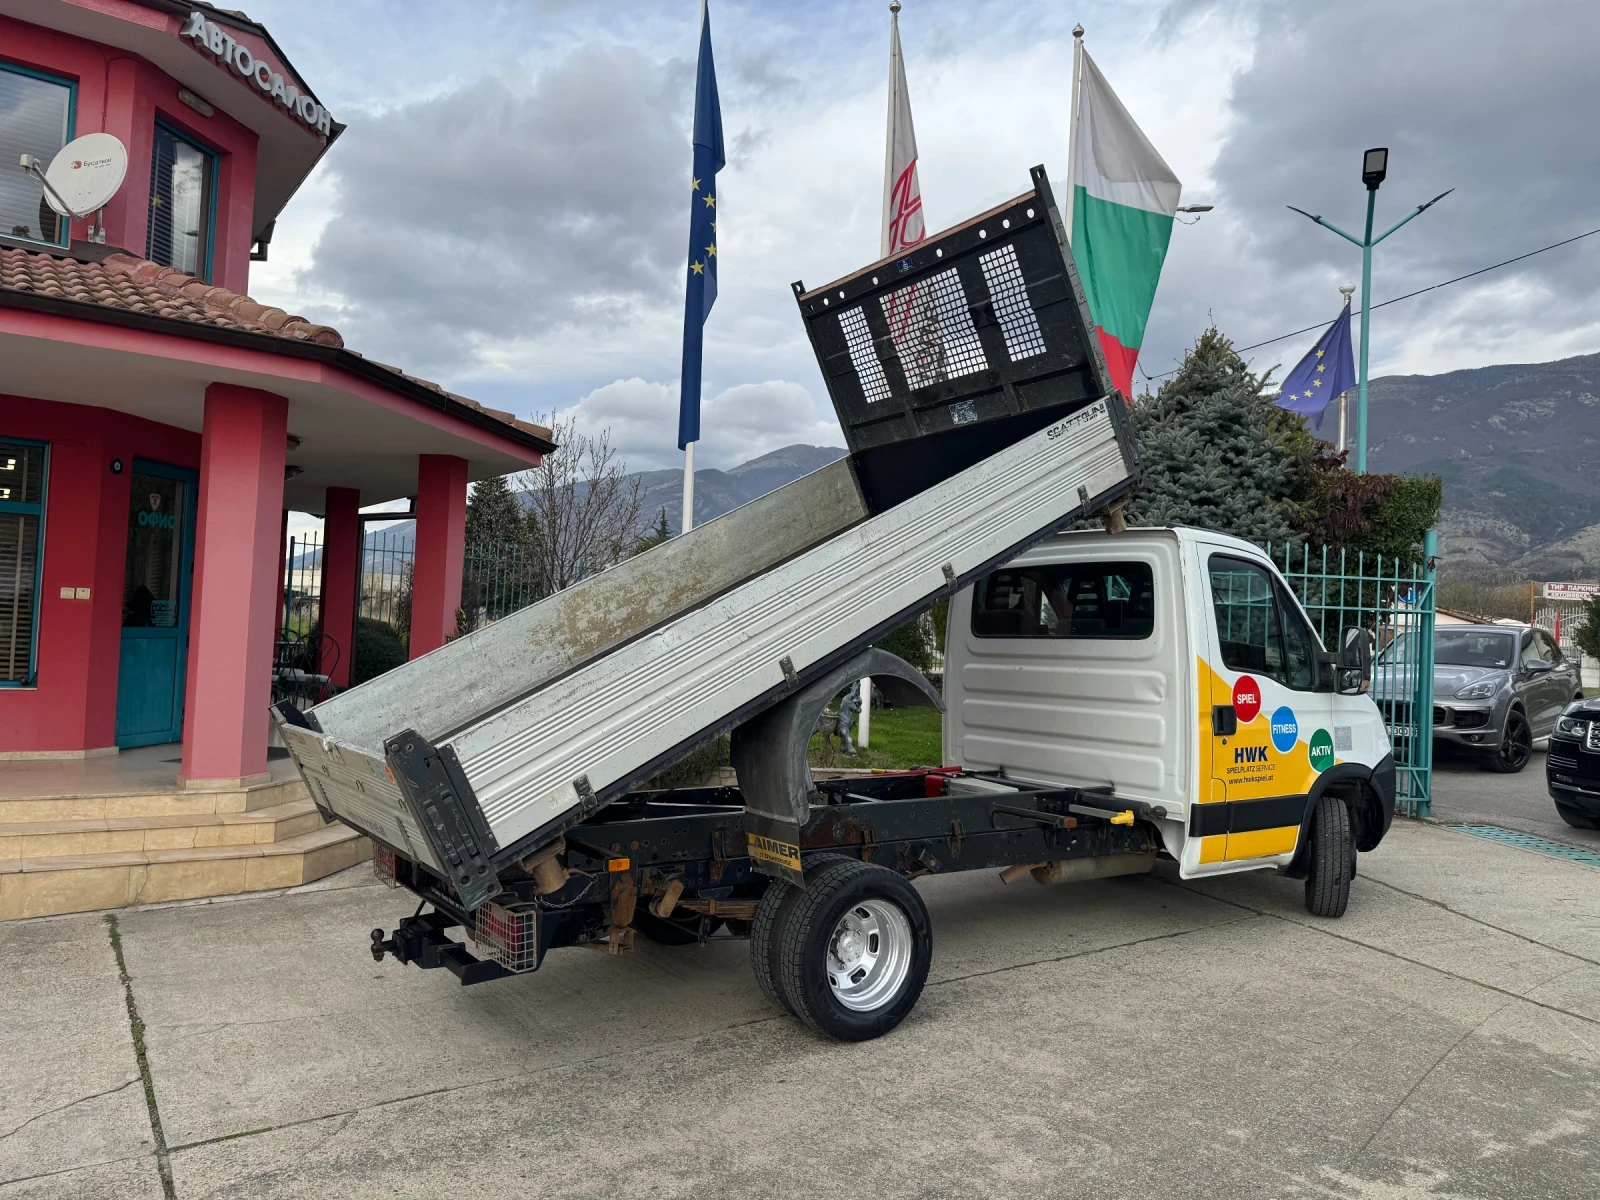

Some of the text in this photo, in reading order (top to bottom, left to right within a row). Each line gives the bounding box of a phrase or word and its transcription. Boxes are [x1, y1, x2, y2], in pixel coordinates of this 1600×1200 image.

[187, 11, 332, 137] АВТОСАЛОН
[138, 511, 175, 530] ОФИС
[1550, 583, 1600, 592] ТИР ПАРКИНГ
[1237, 693, 1257, 704] SPIEL
[1272, 723, 1297, 735] FITNESS
[1234, 746, 1269, 764] HWK
[1311, 745, 1332, 757] AKTIV
[1226, 763, 1276, 775] SPIELPLATZ SERVICE
